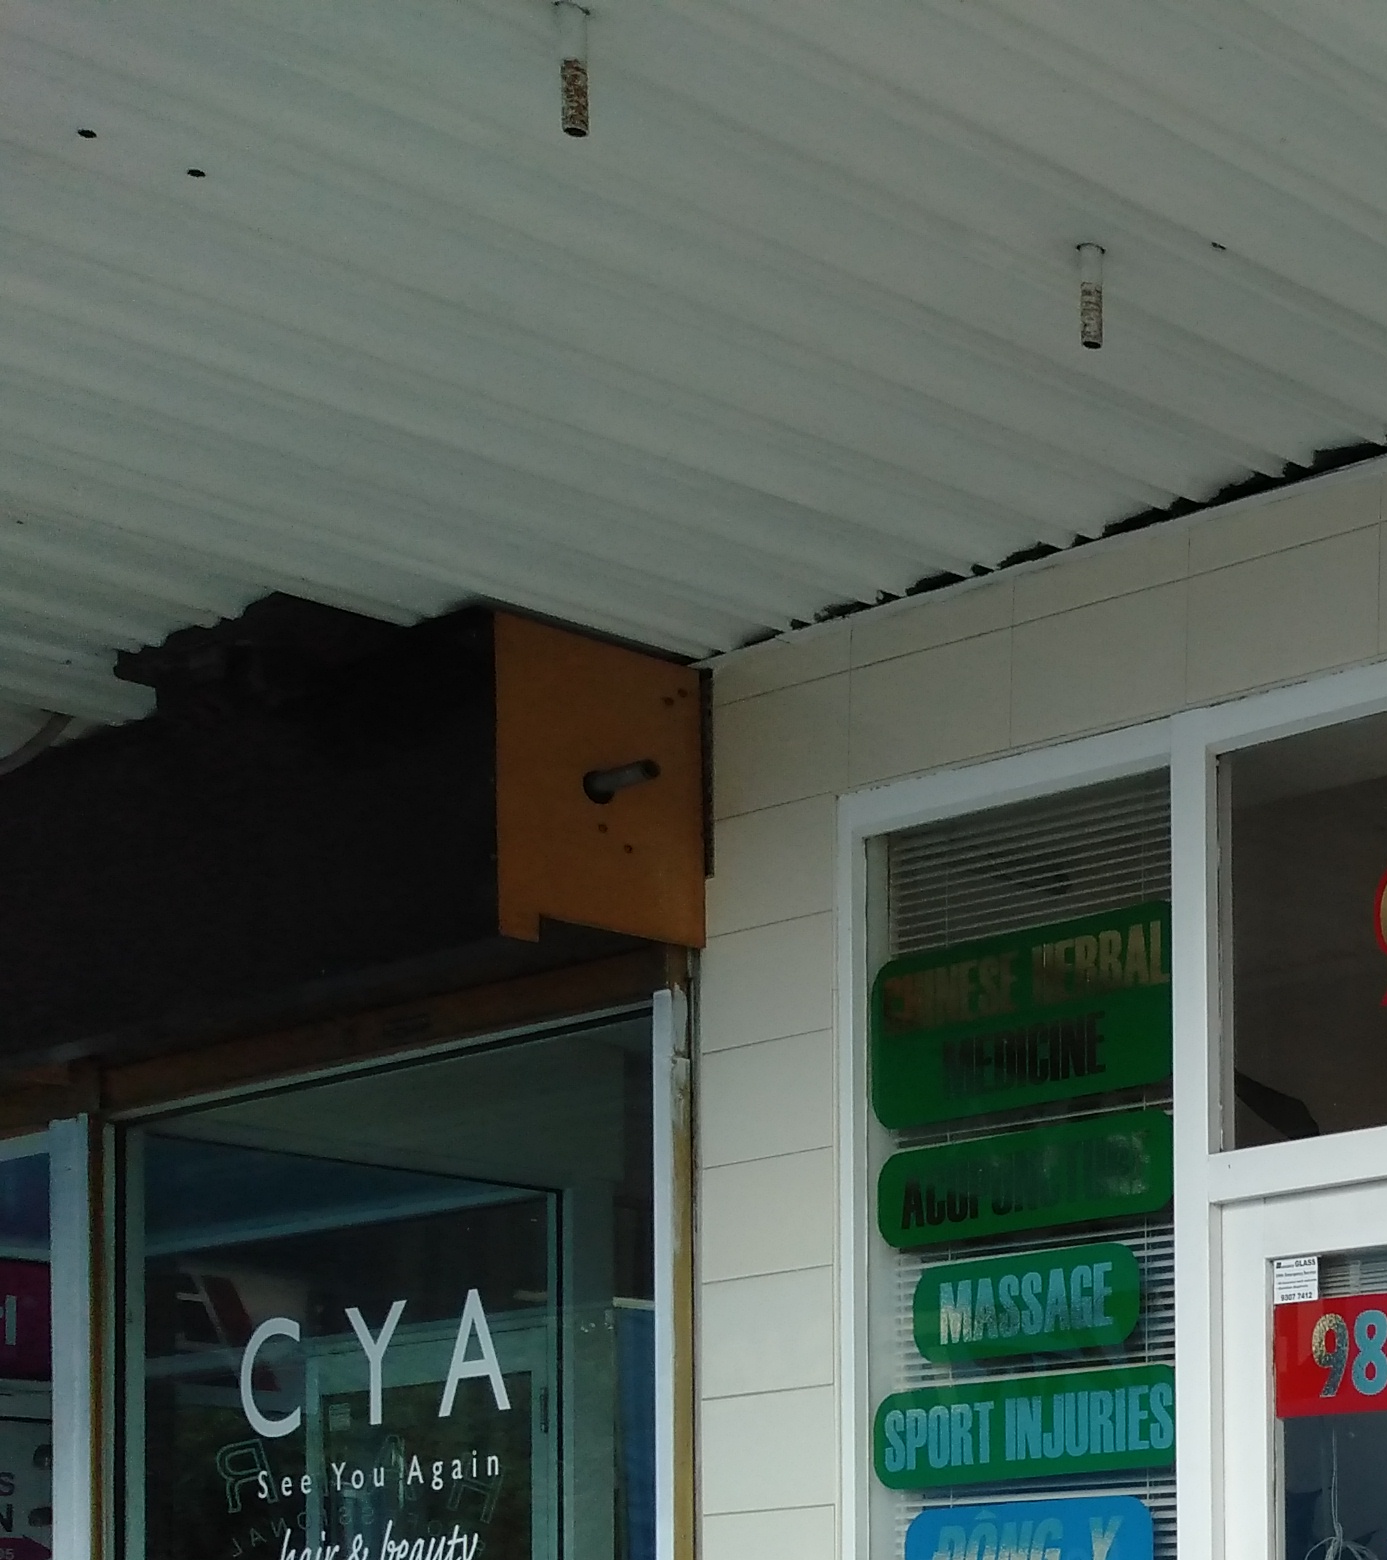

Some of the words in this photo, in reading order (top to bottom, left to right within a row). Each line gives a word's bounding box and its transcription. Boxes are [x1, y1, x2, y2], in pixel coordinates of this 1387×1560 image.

[1032, 920, 1170, 1000] HERBAL
[942, 1011, 1105, 1098] MEDICINE
[939, 1262, 1113, 1345] MASSAGE
[1295, 1259, 1315, 1267] GLASS
[884, 1402, 994, 1472] SPORT
[1004, 1382, 1173, 1461] INJURIES
[257, 1470, 312, 1500] See
[331, 1461, 386, 1491] You
[406, 1450, 500, 1491] Again
